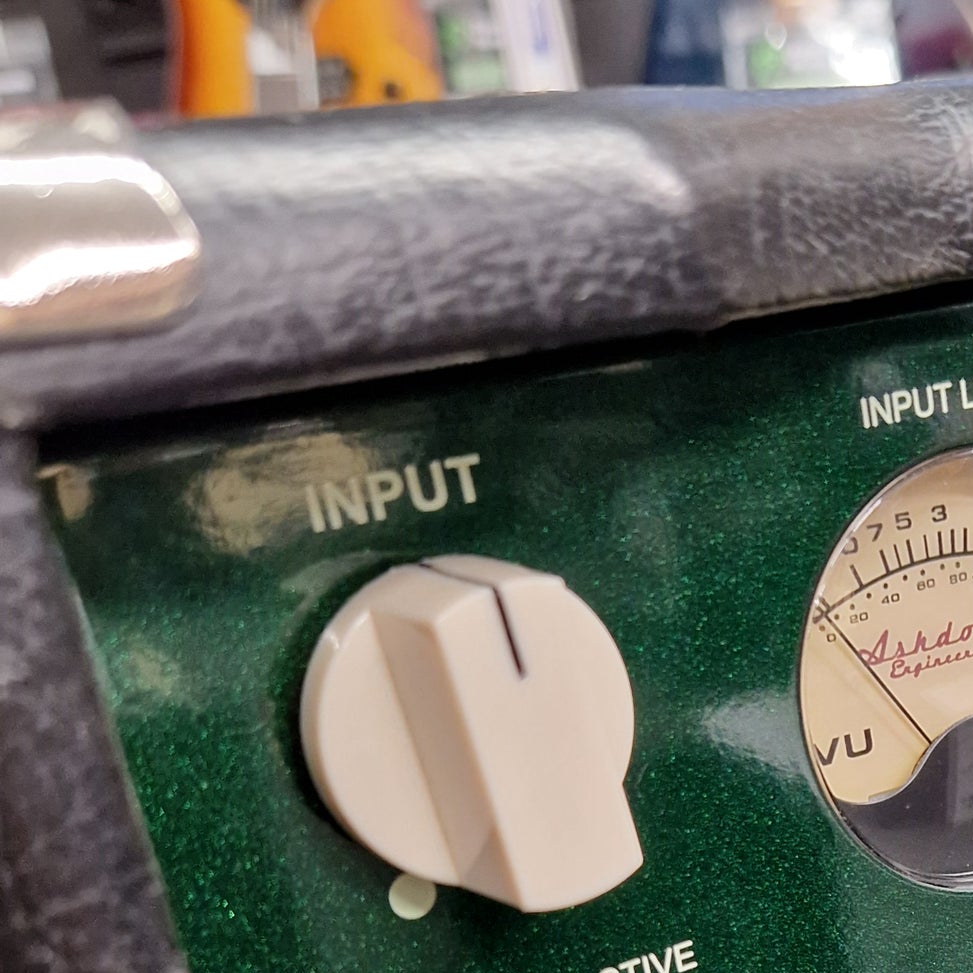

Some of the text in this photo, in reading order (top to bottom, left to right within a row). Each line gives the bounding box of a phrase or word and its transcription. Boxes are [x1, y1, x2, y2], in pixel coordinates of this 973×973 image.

[859, 379, 953, 430] INPUT
[305, 452, 481, 534] INPUT
[866, 522, 883, 543] 7
[894, 511, 913, 531] 5
[930, 503, 948, 523] 3
[849, 611, 869, 624] 20
[881, 592, 901, 605] 40
[916, 577, 936, 591] 60
[949, 570, 968, 585] 80
[813, 728, 874, 767] VU
